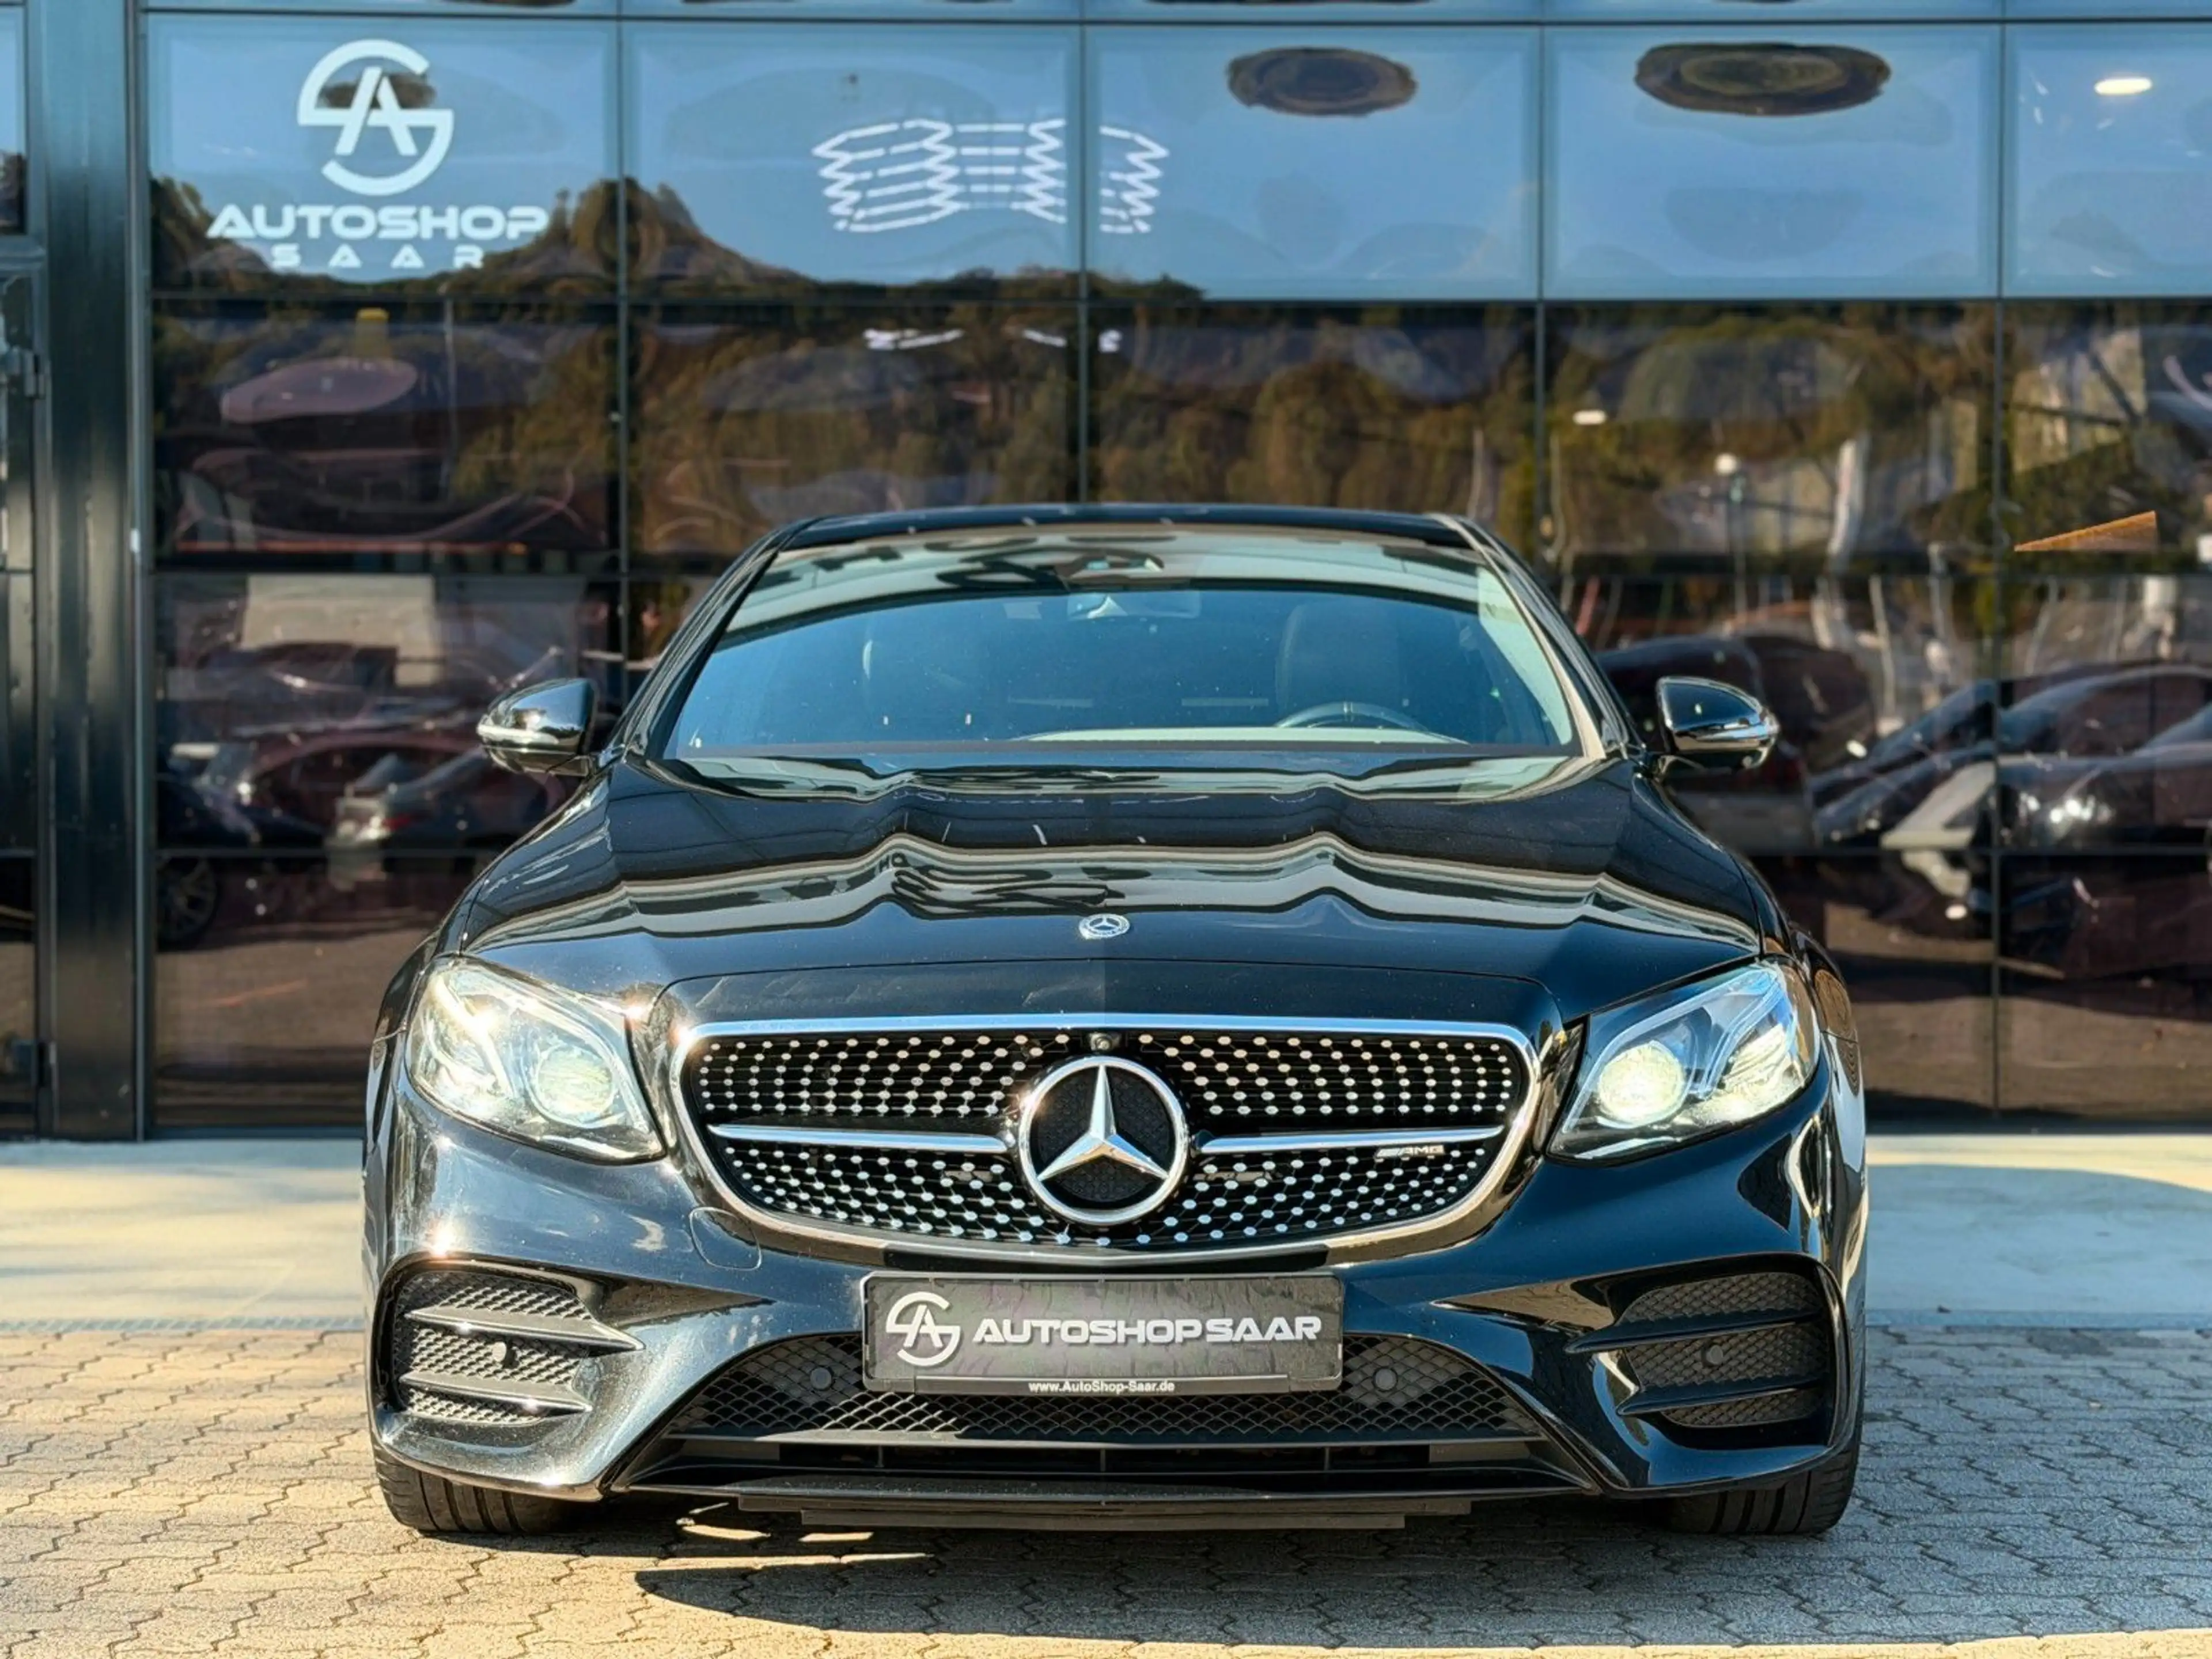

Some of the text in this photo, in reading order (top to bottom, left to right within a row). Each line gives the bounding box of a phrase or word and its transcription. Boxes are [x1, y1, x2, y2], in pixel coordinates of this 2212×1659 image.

[207, 204, 549, 240] AUTOSHOP
[271, 244, 484, 269] SAAR
[1028, 1380, 1175, 1395] www.AutoShop-Saar.de
